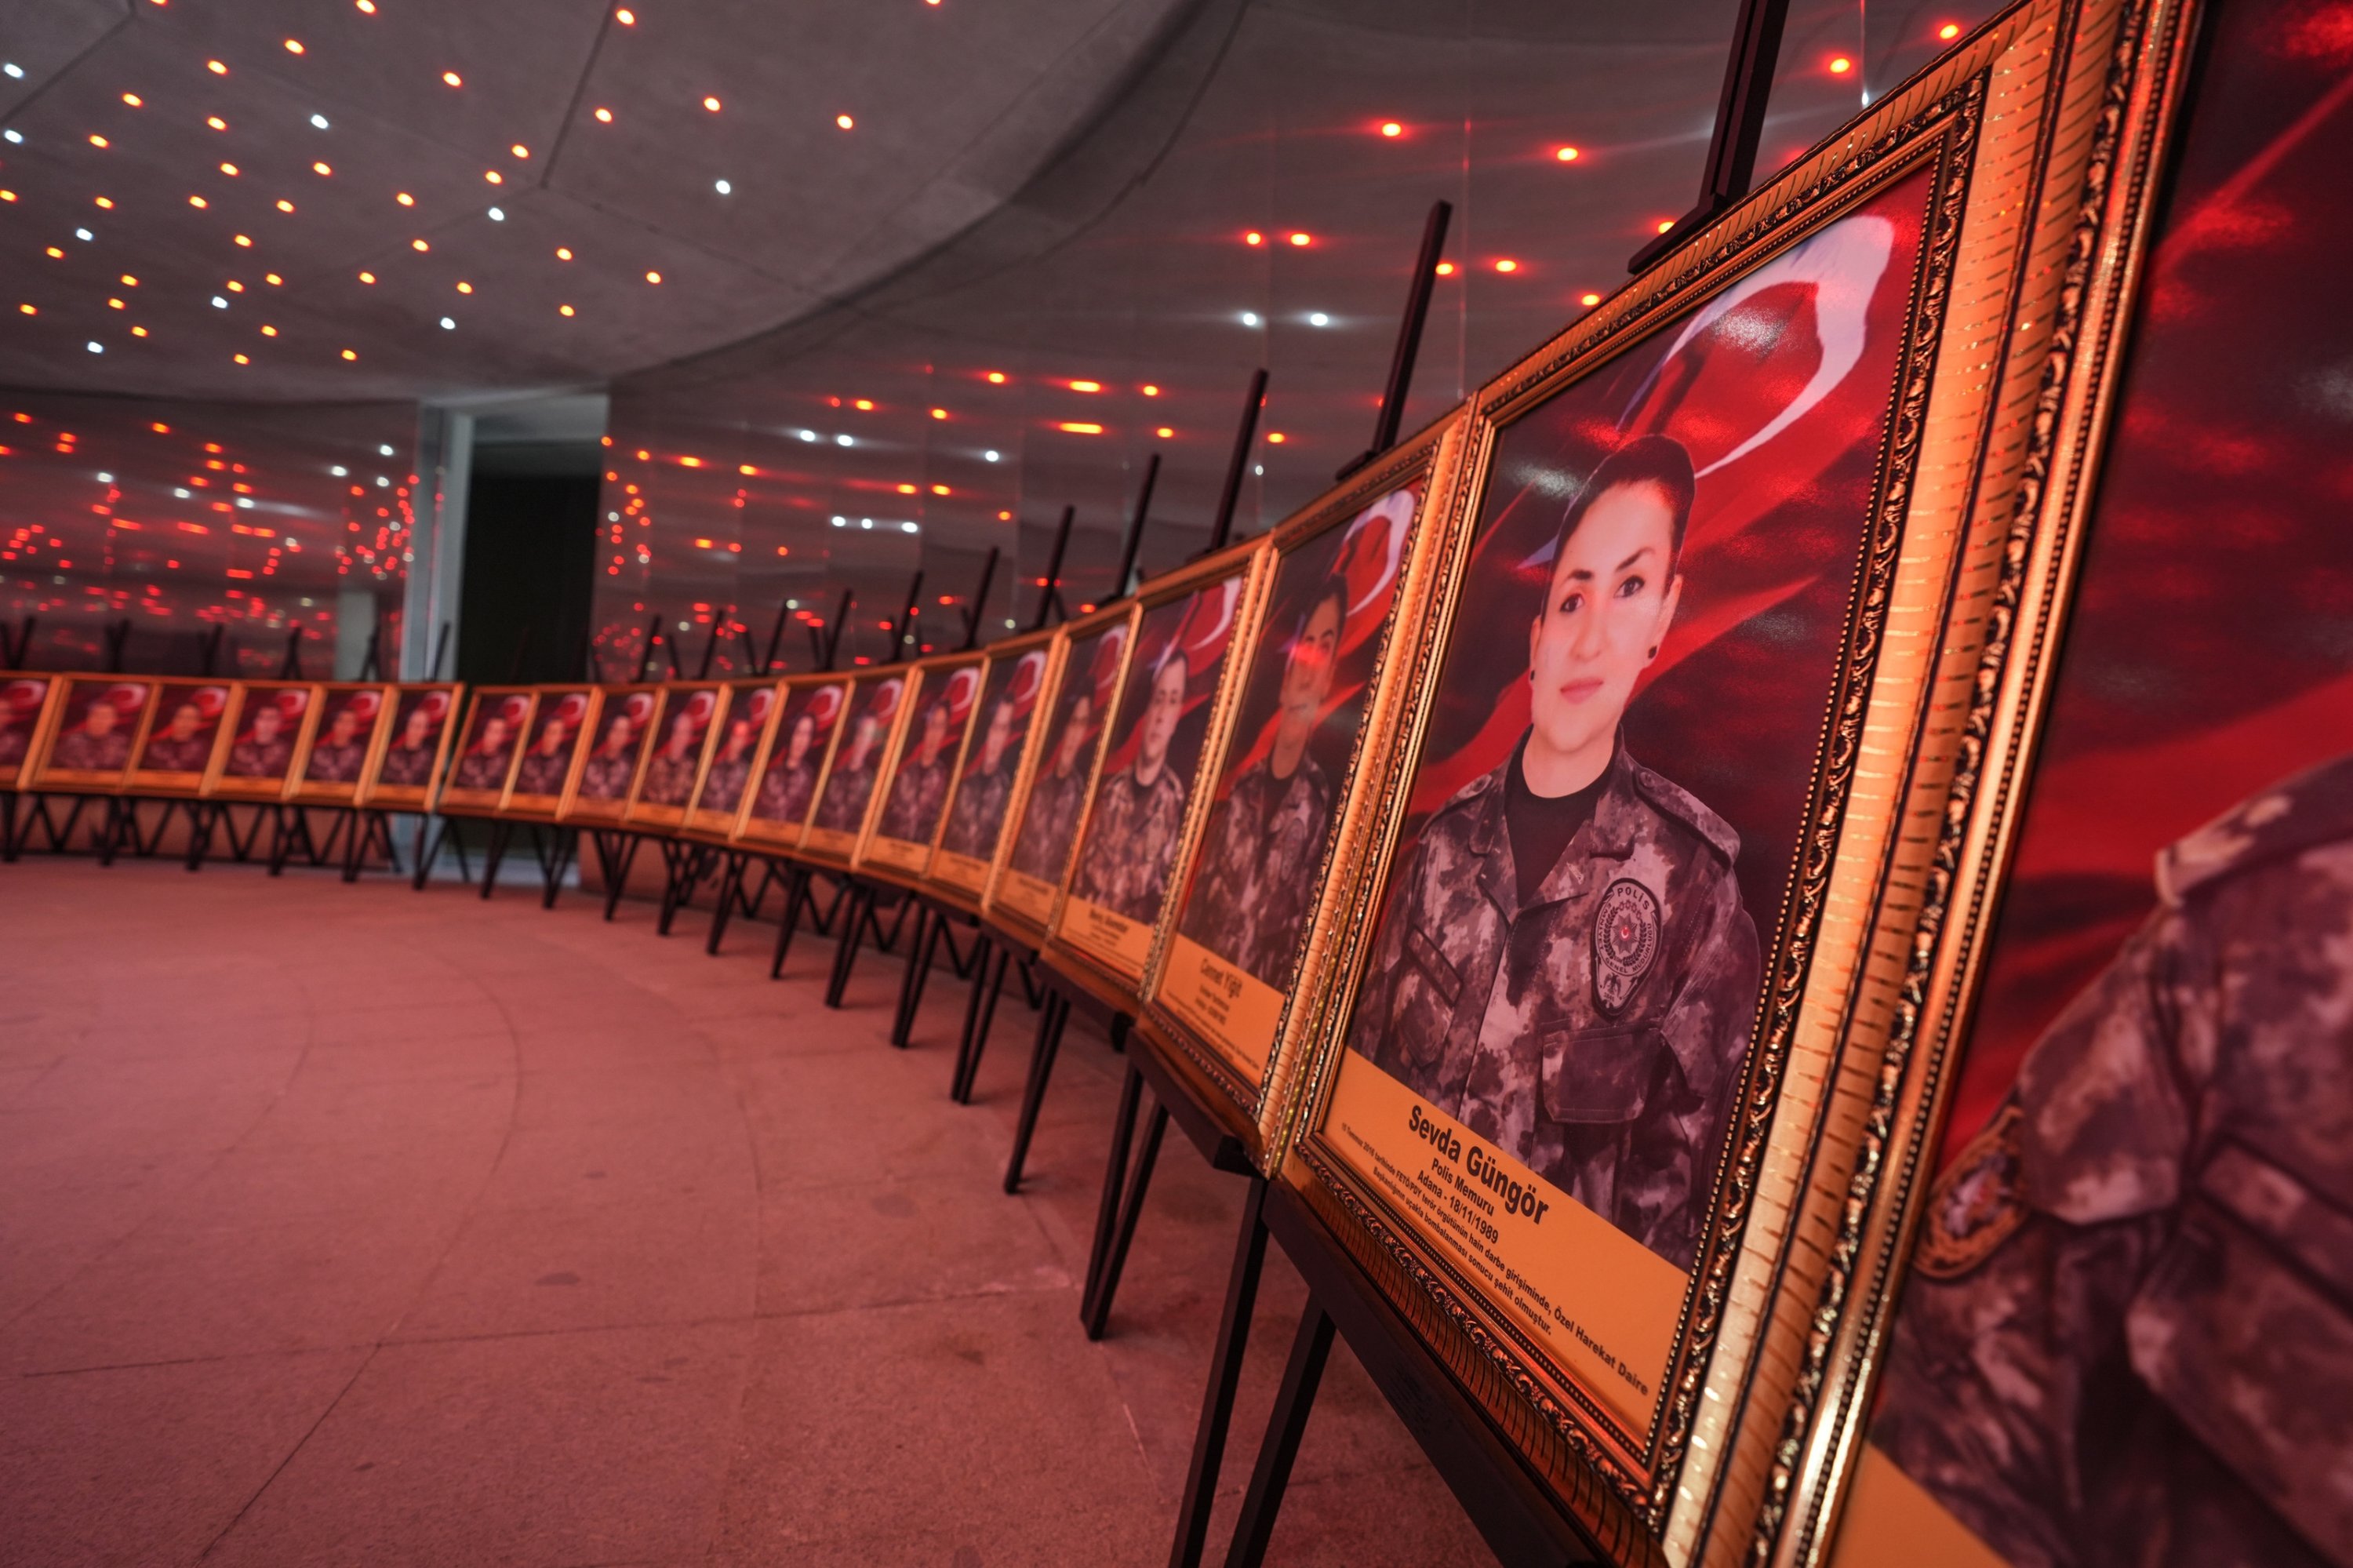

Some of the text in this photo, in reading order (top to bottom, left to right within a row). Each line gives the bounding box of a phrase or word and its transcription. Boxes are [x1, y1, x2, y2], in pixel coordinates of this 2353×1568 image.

[1617, 886, 1649, 910] POLİS
[1605, 957, 1628, 973] GENEL
[1409, 1105, 1549, 1224] Sevda Güngör
[1431, 1158, 1494, 1217] Polis Memuru
[1417, 1170, 1442, 1199] Adana
[1449, 1195, 1498, 1244] 18/11/1989
[1375, 1152, 1395, 1175] tarihinde
[1395, 1170, 1422, 1198] FETÖ/PDY
[1422, 1193, 1436, 1211] terör
[1437, 1206, 1467, 1239] örgütünün
[1469, 1233, 1483, 1253] hain
[1485, 1248, 1504, 1271] darbe
[1505, 1268, 1551, 1315] girişiminde,
[1554, 1305, 1574, 1332] Özel
[1575, 1326, 1616, 1369] Harekat
[1617, 1361, 1649, 1395] Daire
[1406, 1197, 1424, 1217] uçakla
[1424, 1212, 1467, 1258] bombalanması
[1468, 1254, 1493, 1281] sonucu
[1493, 1278, 1514, 1300] şehit
[1515, 1295, 1551, 1335] olmuştur.
